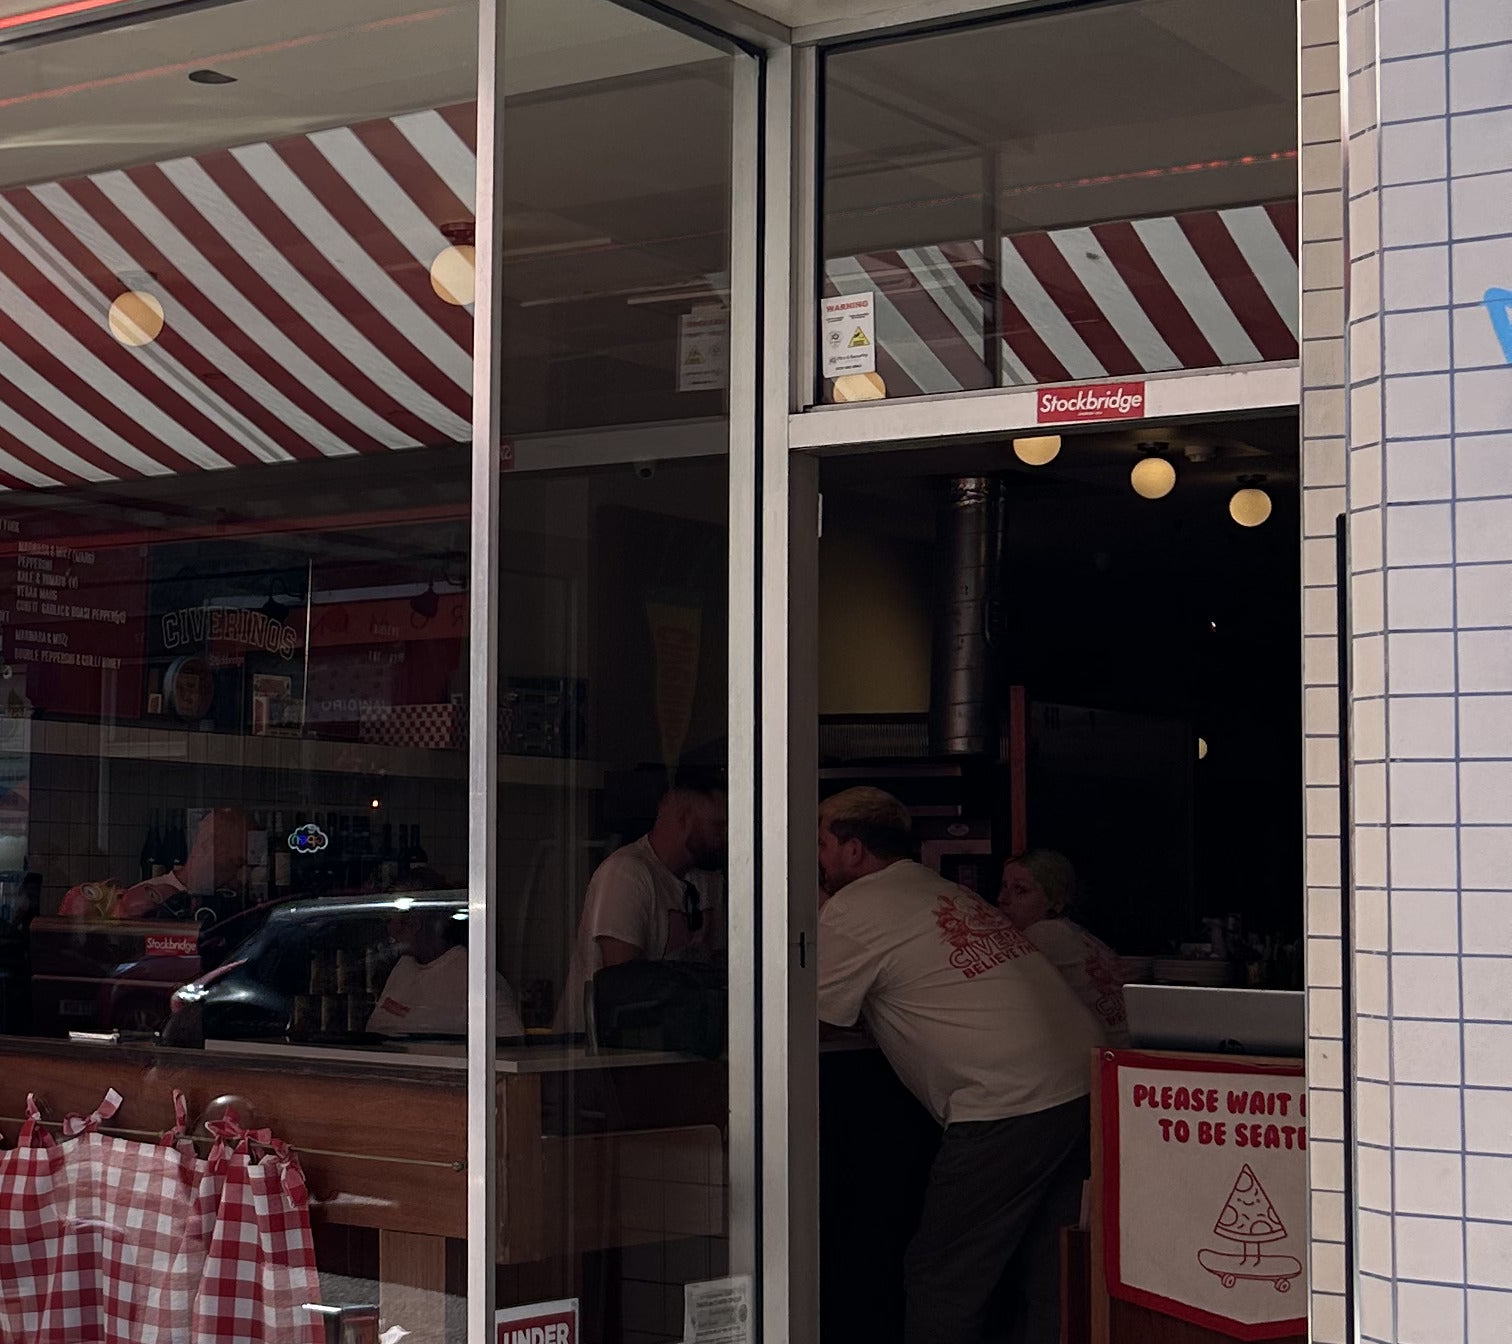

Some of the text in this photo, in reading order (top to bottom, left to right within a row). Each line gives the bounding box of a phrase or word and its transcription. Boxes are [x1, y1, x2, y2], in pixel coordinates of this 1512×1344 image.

[1040, 387, 1143, 414] Stockbridge
[161, 605, 297, 661] CIVERINOS
[145, 936, 196, 954] Stockbridge
[1132, 1084, 1219, 1113] PLEASE
[1227, 1090, 1292, 1117] WAIT
[1158, 1118, 1190, 1143] TO
[1197, 1121, 1226, 1146] BE
